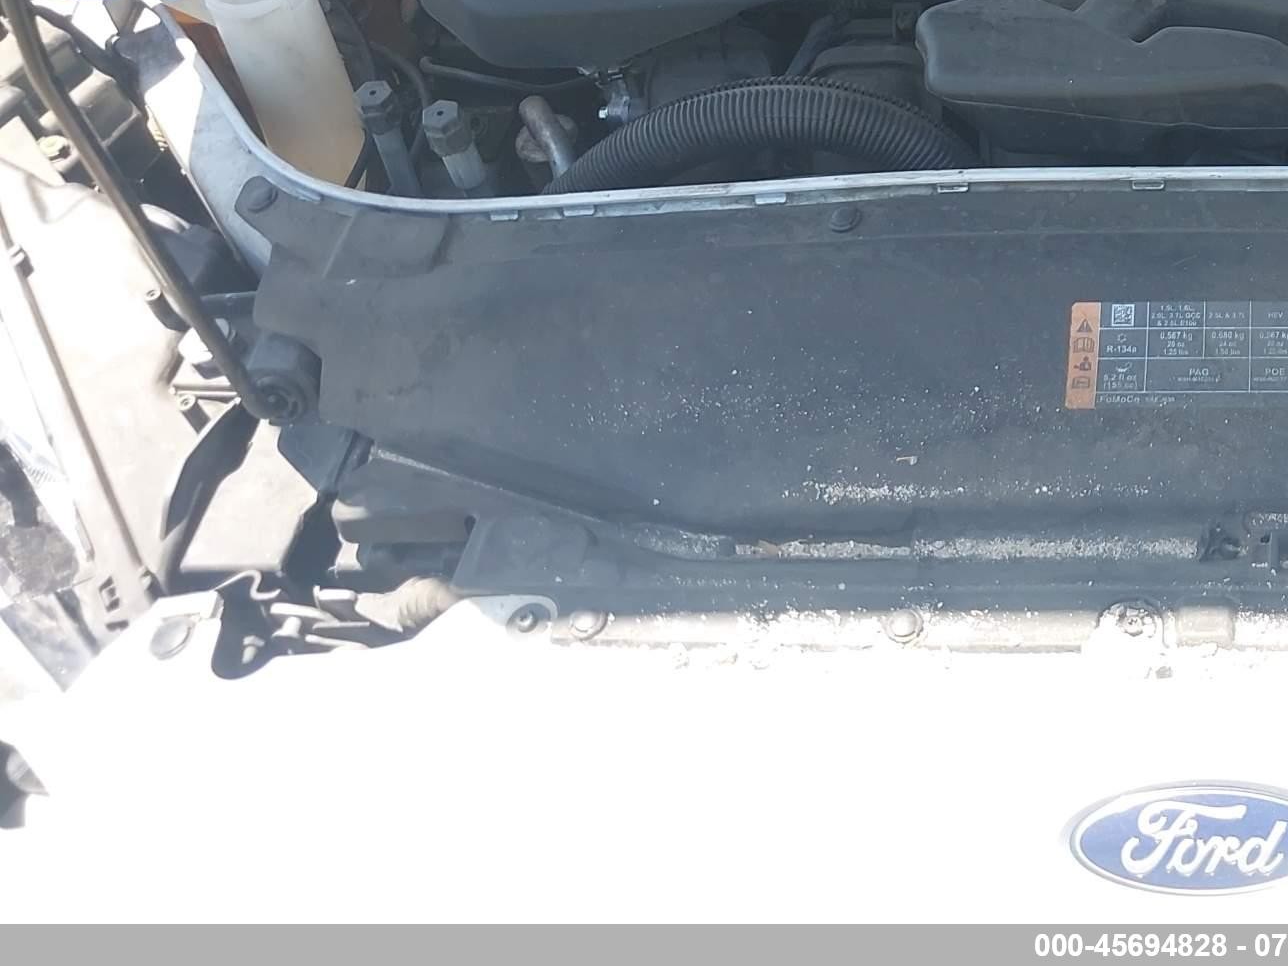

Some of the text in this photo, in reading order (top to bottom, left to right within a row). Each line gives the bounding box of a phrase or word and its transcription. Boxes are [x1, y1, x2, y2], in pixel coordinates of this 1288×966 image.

[1183, 330, 1193, 342] kg
[1234, 330, 1245, 341] kg
[1106, 345, 1137, 353] R-134a
[1188, 367, 1209, 376] PAG
[1264, 367, 1286, 376] POE
[1120, 800, 1288, 877] Ford
